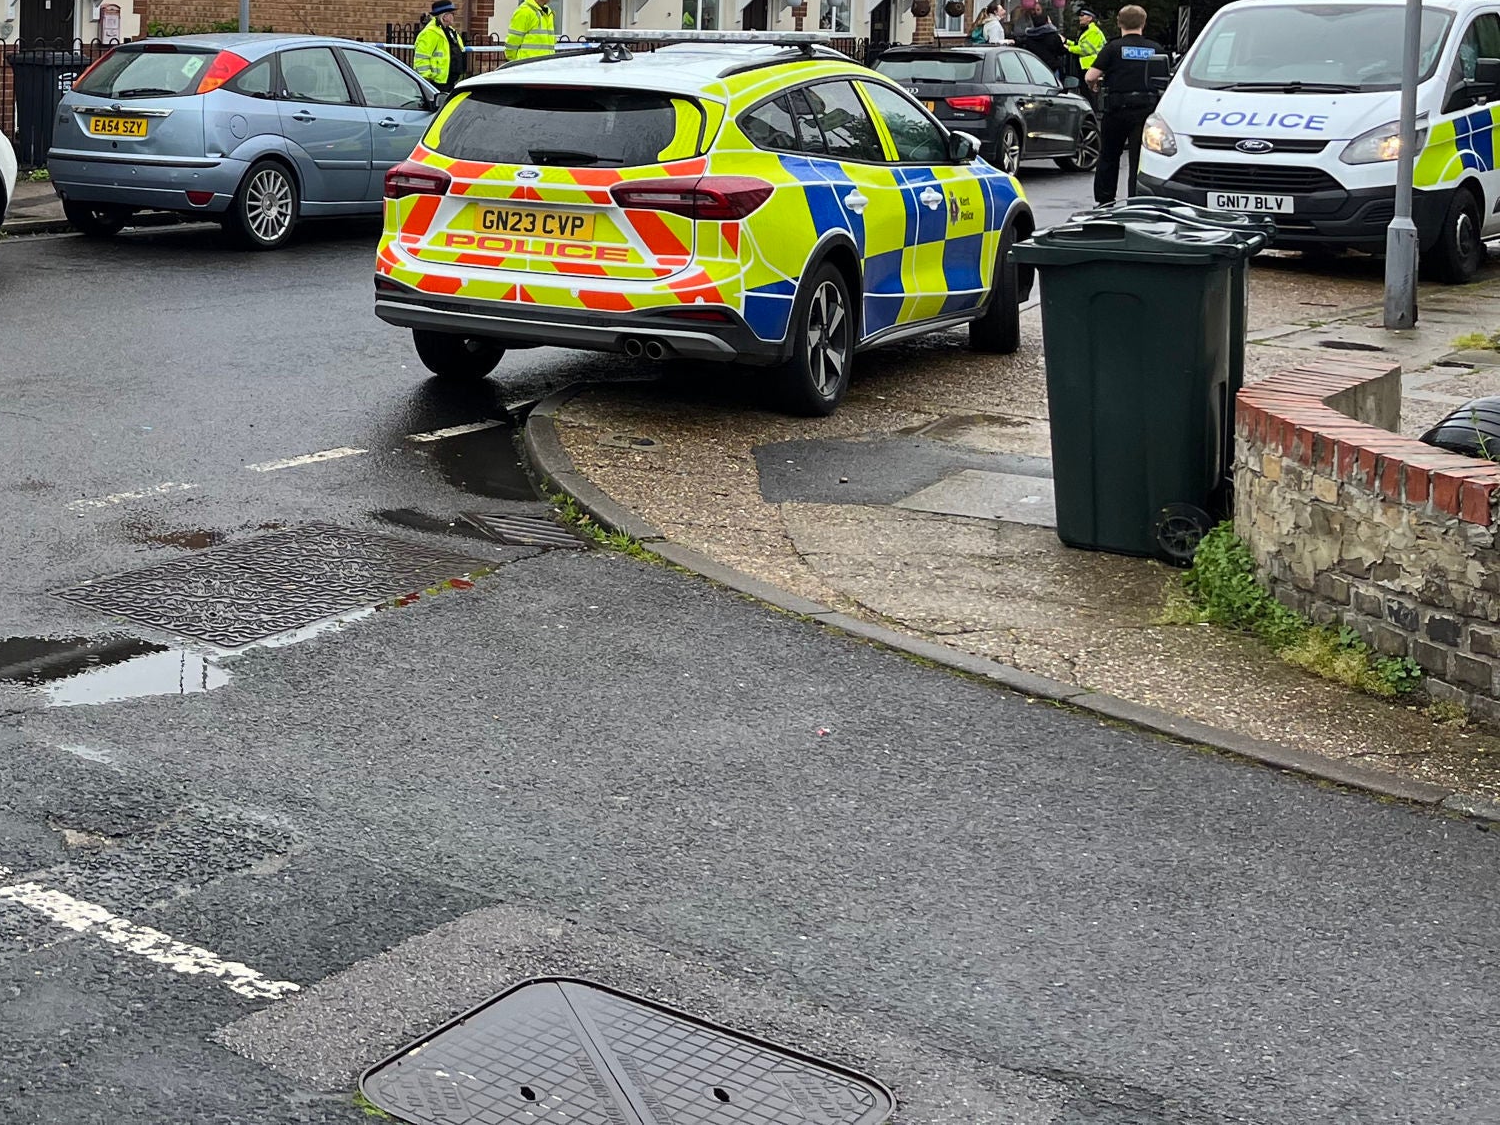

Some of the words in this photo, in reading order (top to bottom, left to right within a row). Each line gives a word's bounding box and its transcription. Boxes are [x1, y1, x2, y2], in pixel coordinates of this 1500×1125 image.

[94, 120, 119, 132] EA54
[122, 121, 142, 133] SZY
[1197, 112, 1329, 131] POLICE
[1216, 195, 1250, 209] GN17
[1254, 196, 1284, 210] BLV
[482, 210, 536, 233] GN23
[542, 214, 585, 237] CVP
[445, 234, 630, 263] POLICE
